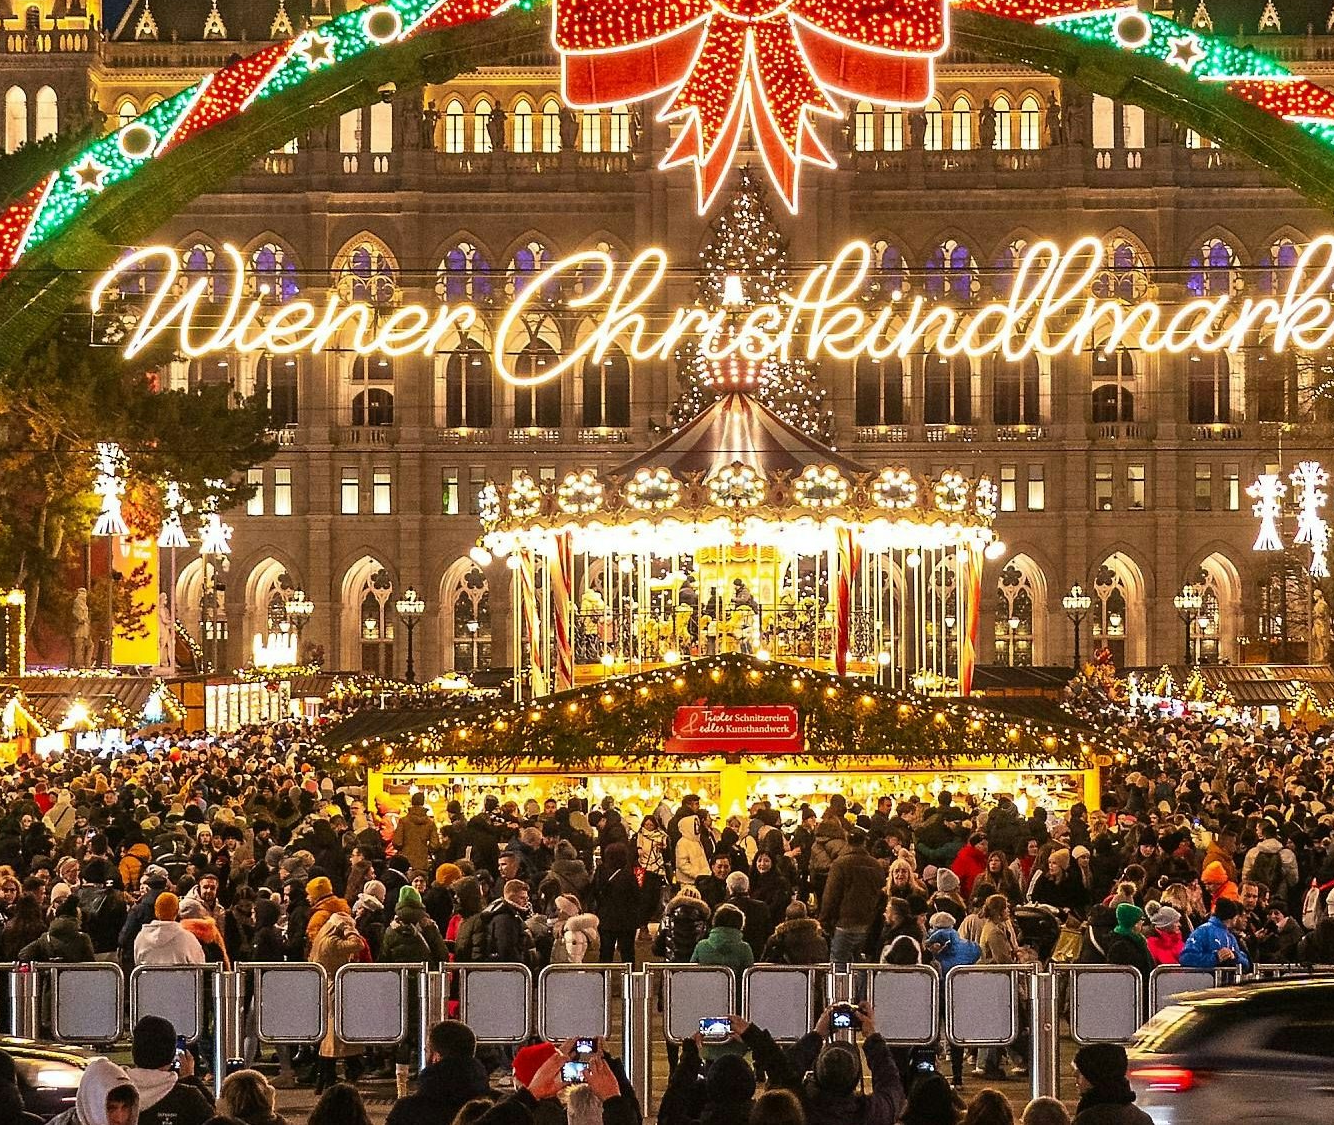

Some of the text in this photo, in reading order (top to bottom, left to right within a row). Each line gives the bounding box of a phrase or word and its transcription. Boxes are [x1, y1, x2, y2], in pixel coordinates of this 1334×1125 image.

[90, 241, 479, 360] Wiener
[734, 713, 789, 722] Schnitzereien
[699, 722, 725, 733] edles
[726, 724, 790, 733] Kunsthandwerk
